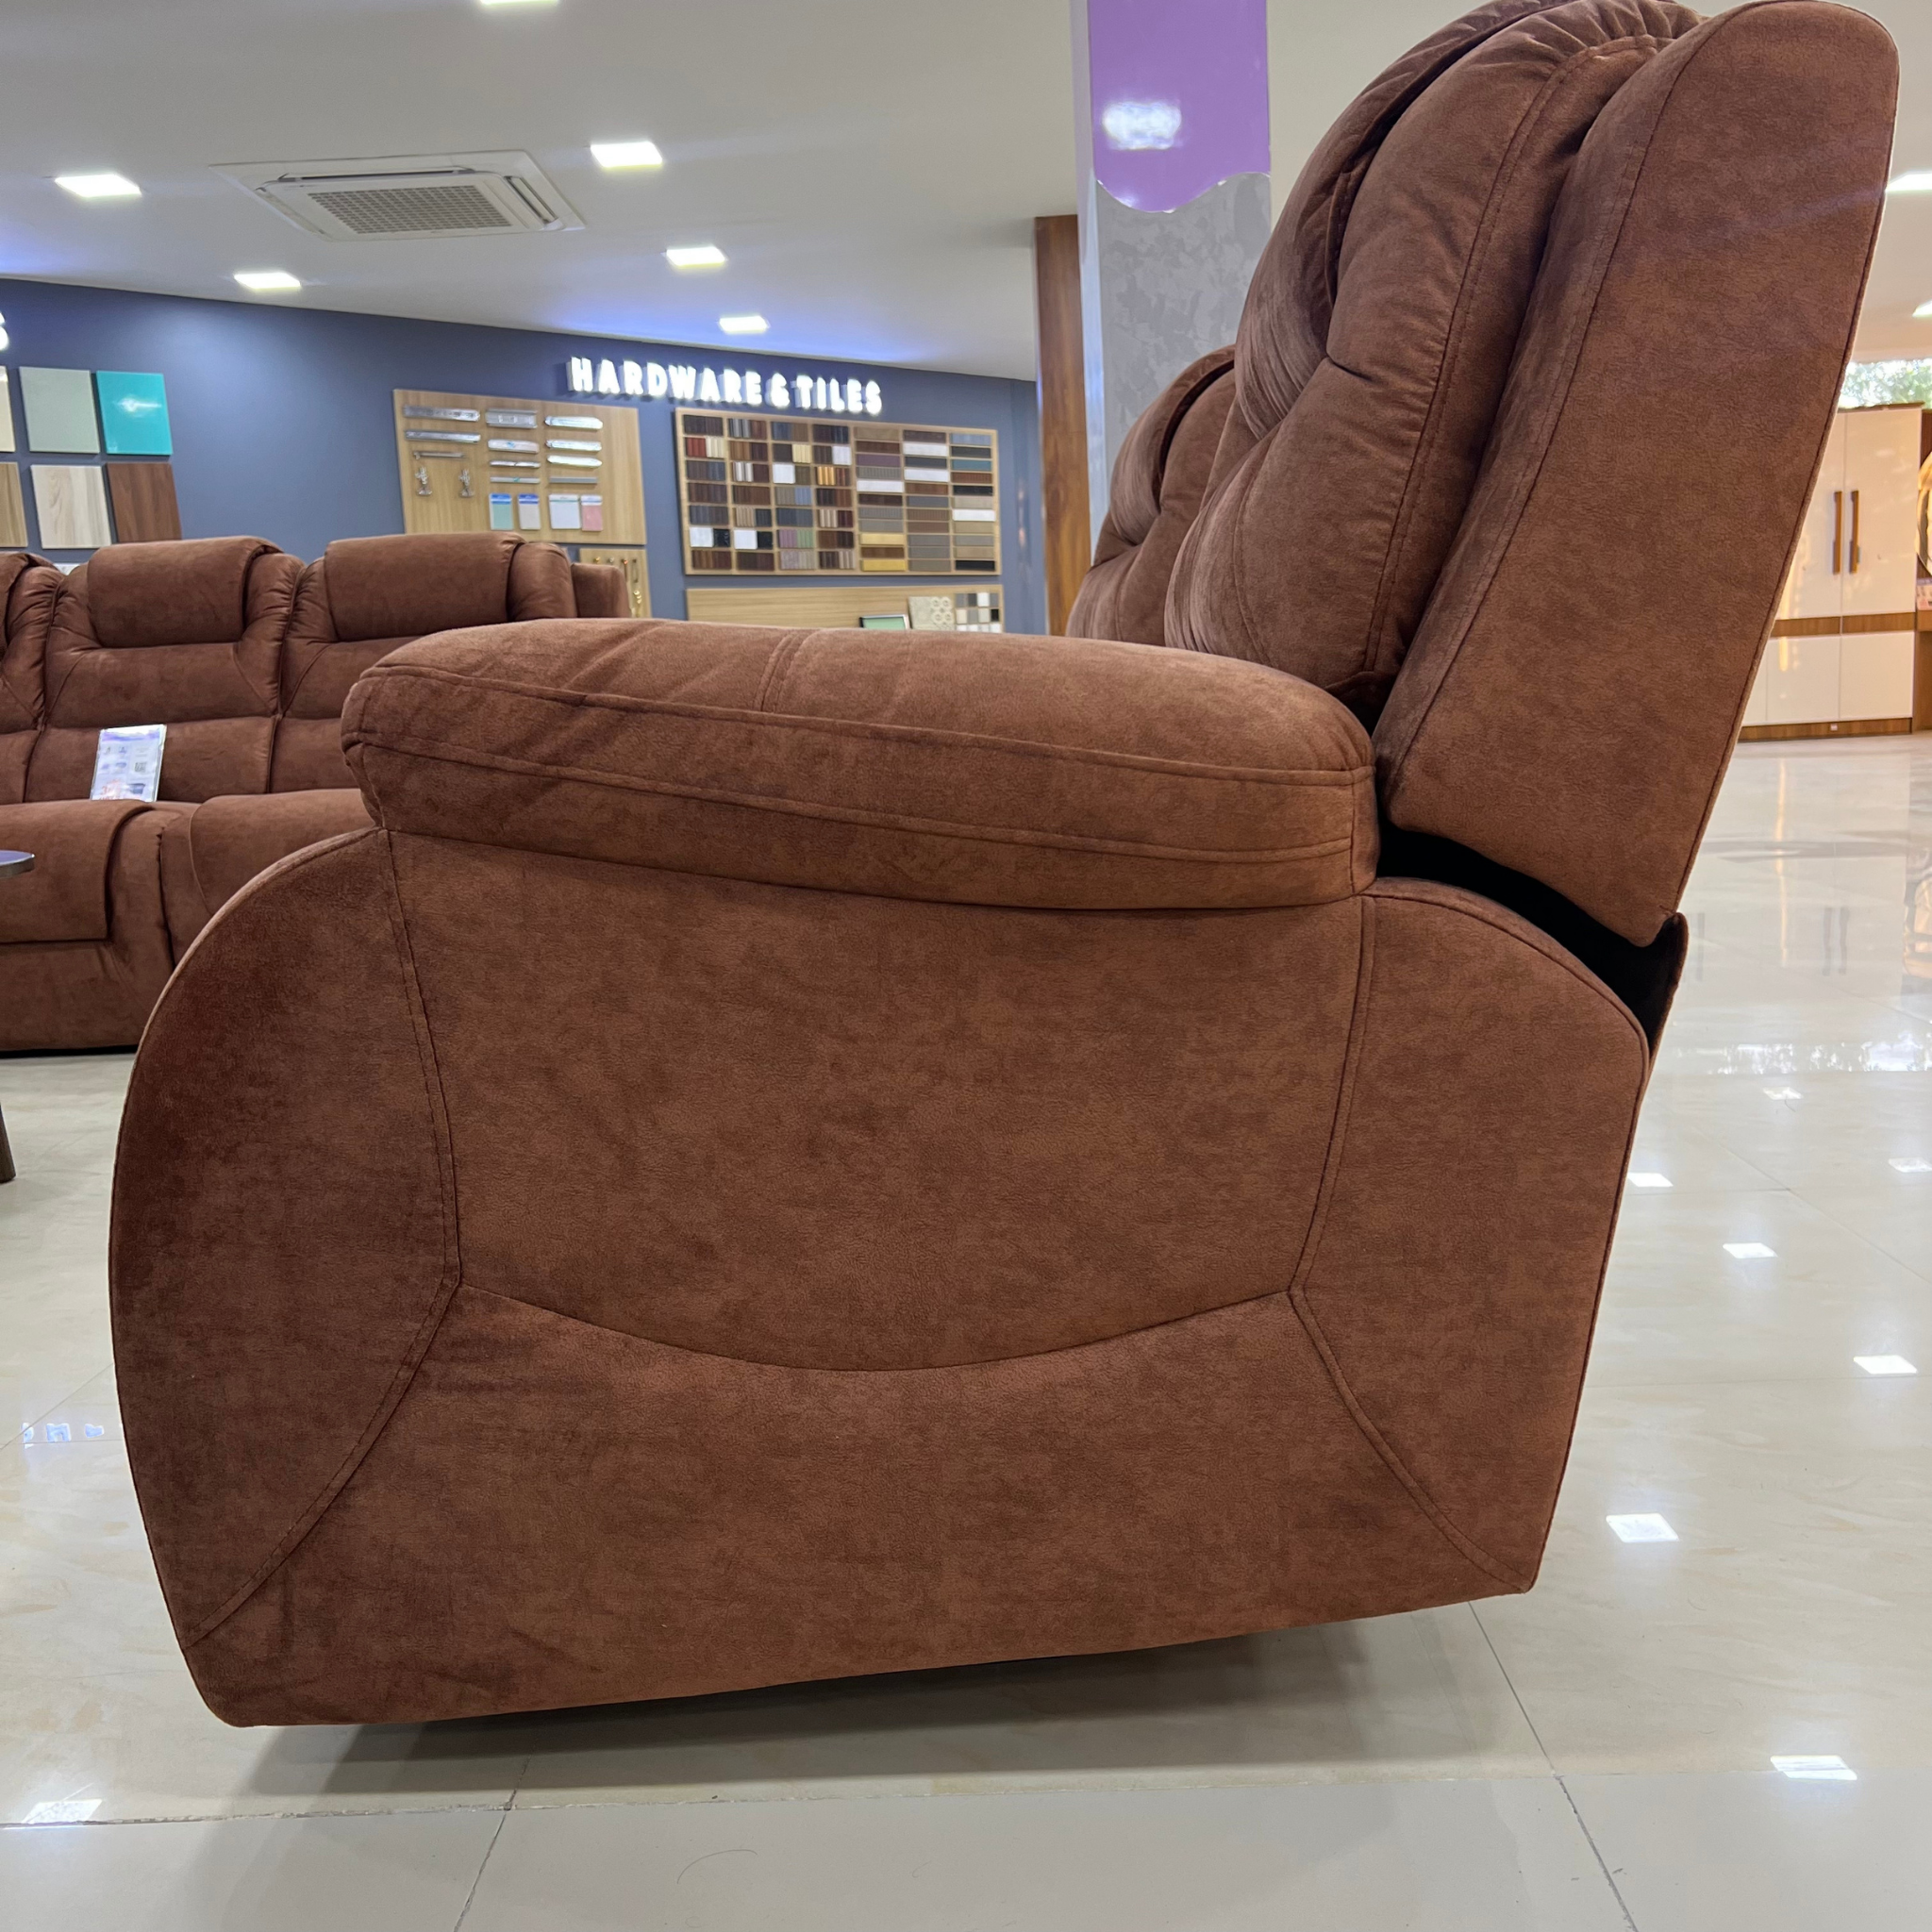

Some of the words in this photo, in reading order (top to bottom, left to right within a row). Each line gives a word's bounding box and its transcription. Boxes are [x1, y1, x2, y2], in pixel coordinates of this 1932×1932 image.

[569, 357, 762, 406] HARDWARE
[769, 372, 791, 409] &
[794, 375, 882, 415] TILES
